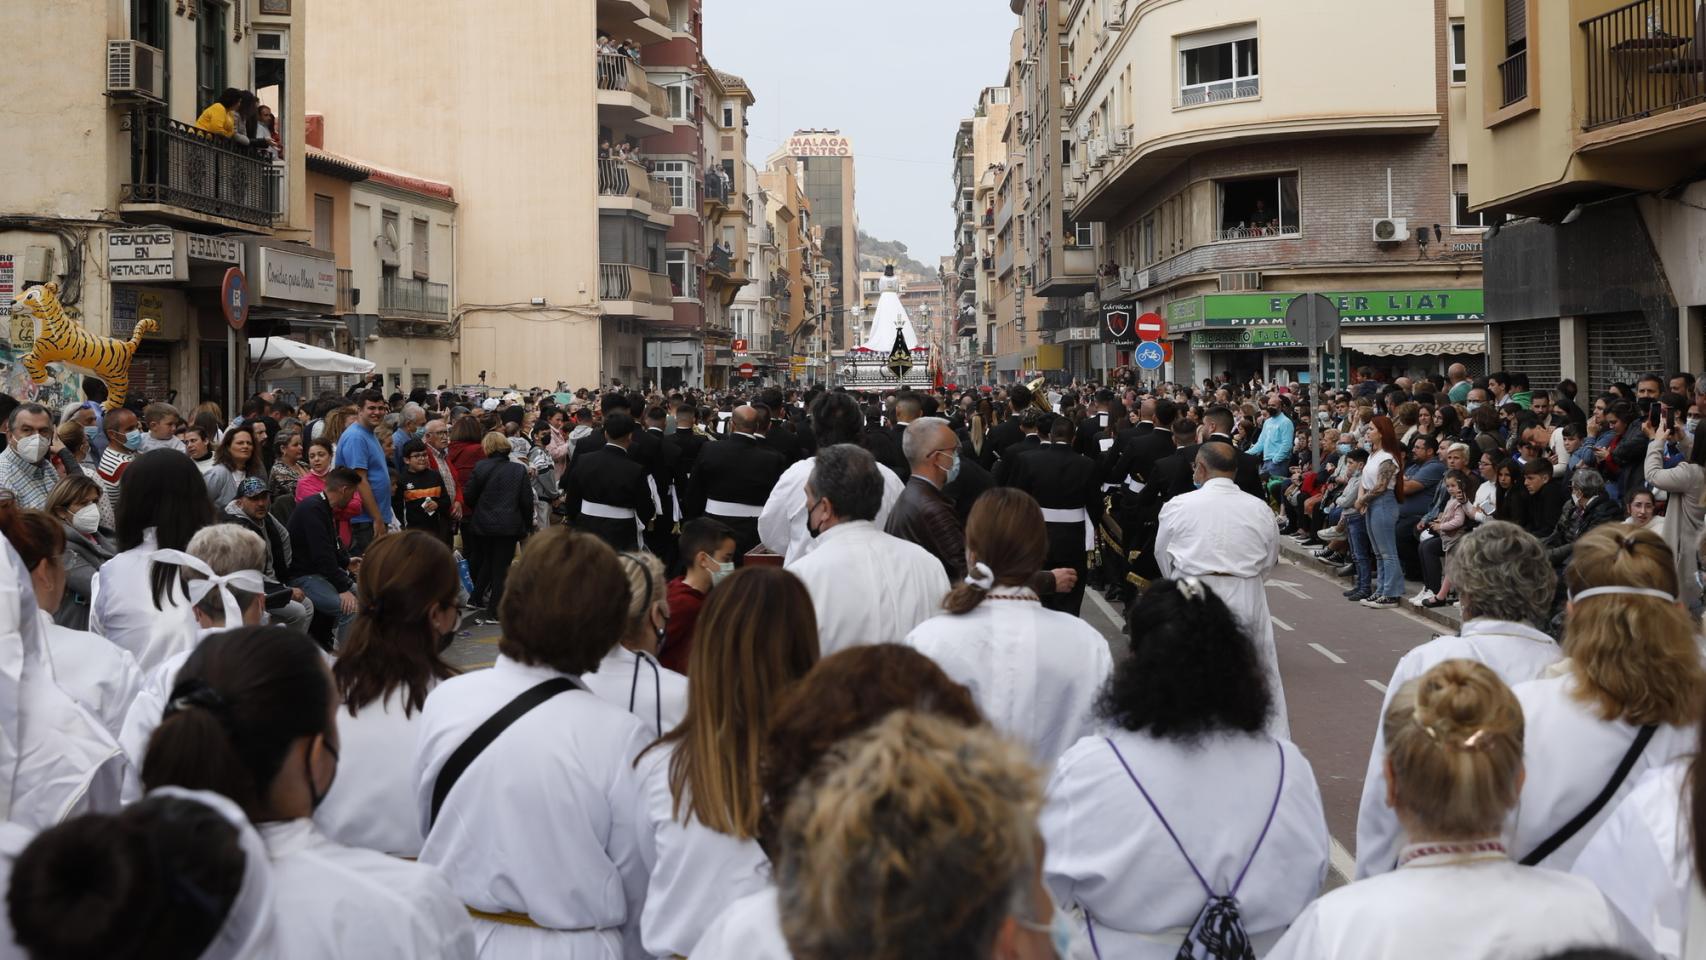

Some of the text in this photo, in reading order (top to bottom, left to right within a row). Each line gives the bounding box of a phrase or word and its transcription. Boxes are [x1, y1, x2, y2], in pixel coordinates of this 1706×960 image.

[790, 138, 849, 147] MALAGA
[791, 147, 849, 156] CENTRO
[110, 234, 172, 246] CREACIONES
[135, 247, 150, 259] EN
[110, 264, 172, 276] METACRILATO
[1270, 294, 1451, 312] EER LIAT
[1231, 318, 1284, 326] PIJAM
[1340, 313, 1431, 323] AMISONES
